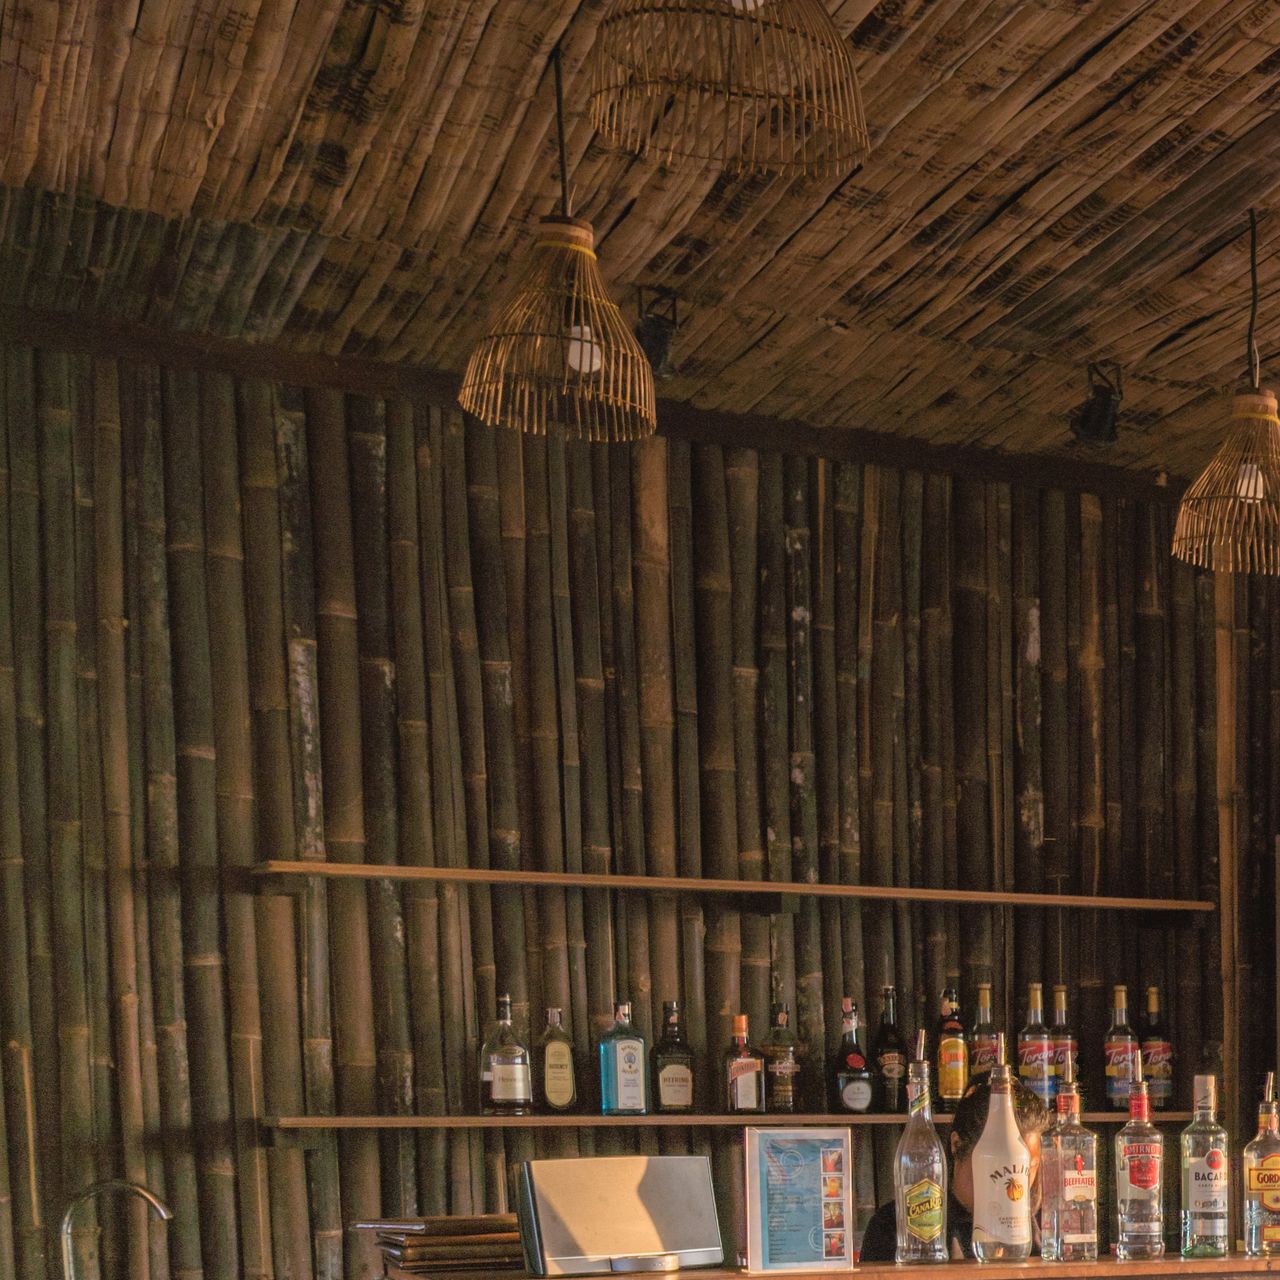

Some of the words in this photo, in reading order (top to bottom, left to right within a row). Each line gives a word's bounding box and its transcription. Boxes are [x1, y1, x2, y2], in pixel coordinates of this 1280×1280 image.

[1124, 1144, 1161, 1156] SMIRNO
[989, 1164, 1029, 1184] MALIB
[1063, 1177, 1095, 1187] BEEFEATER
